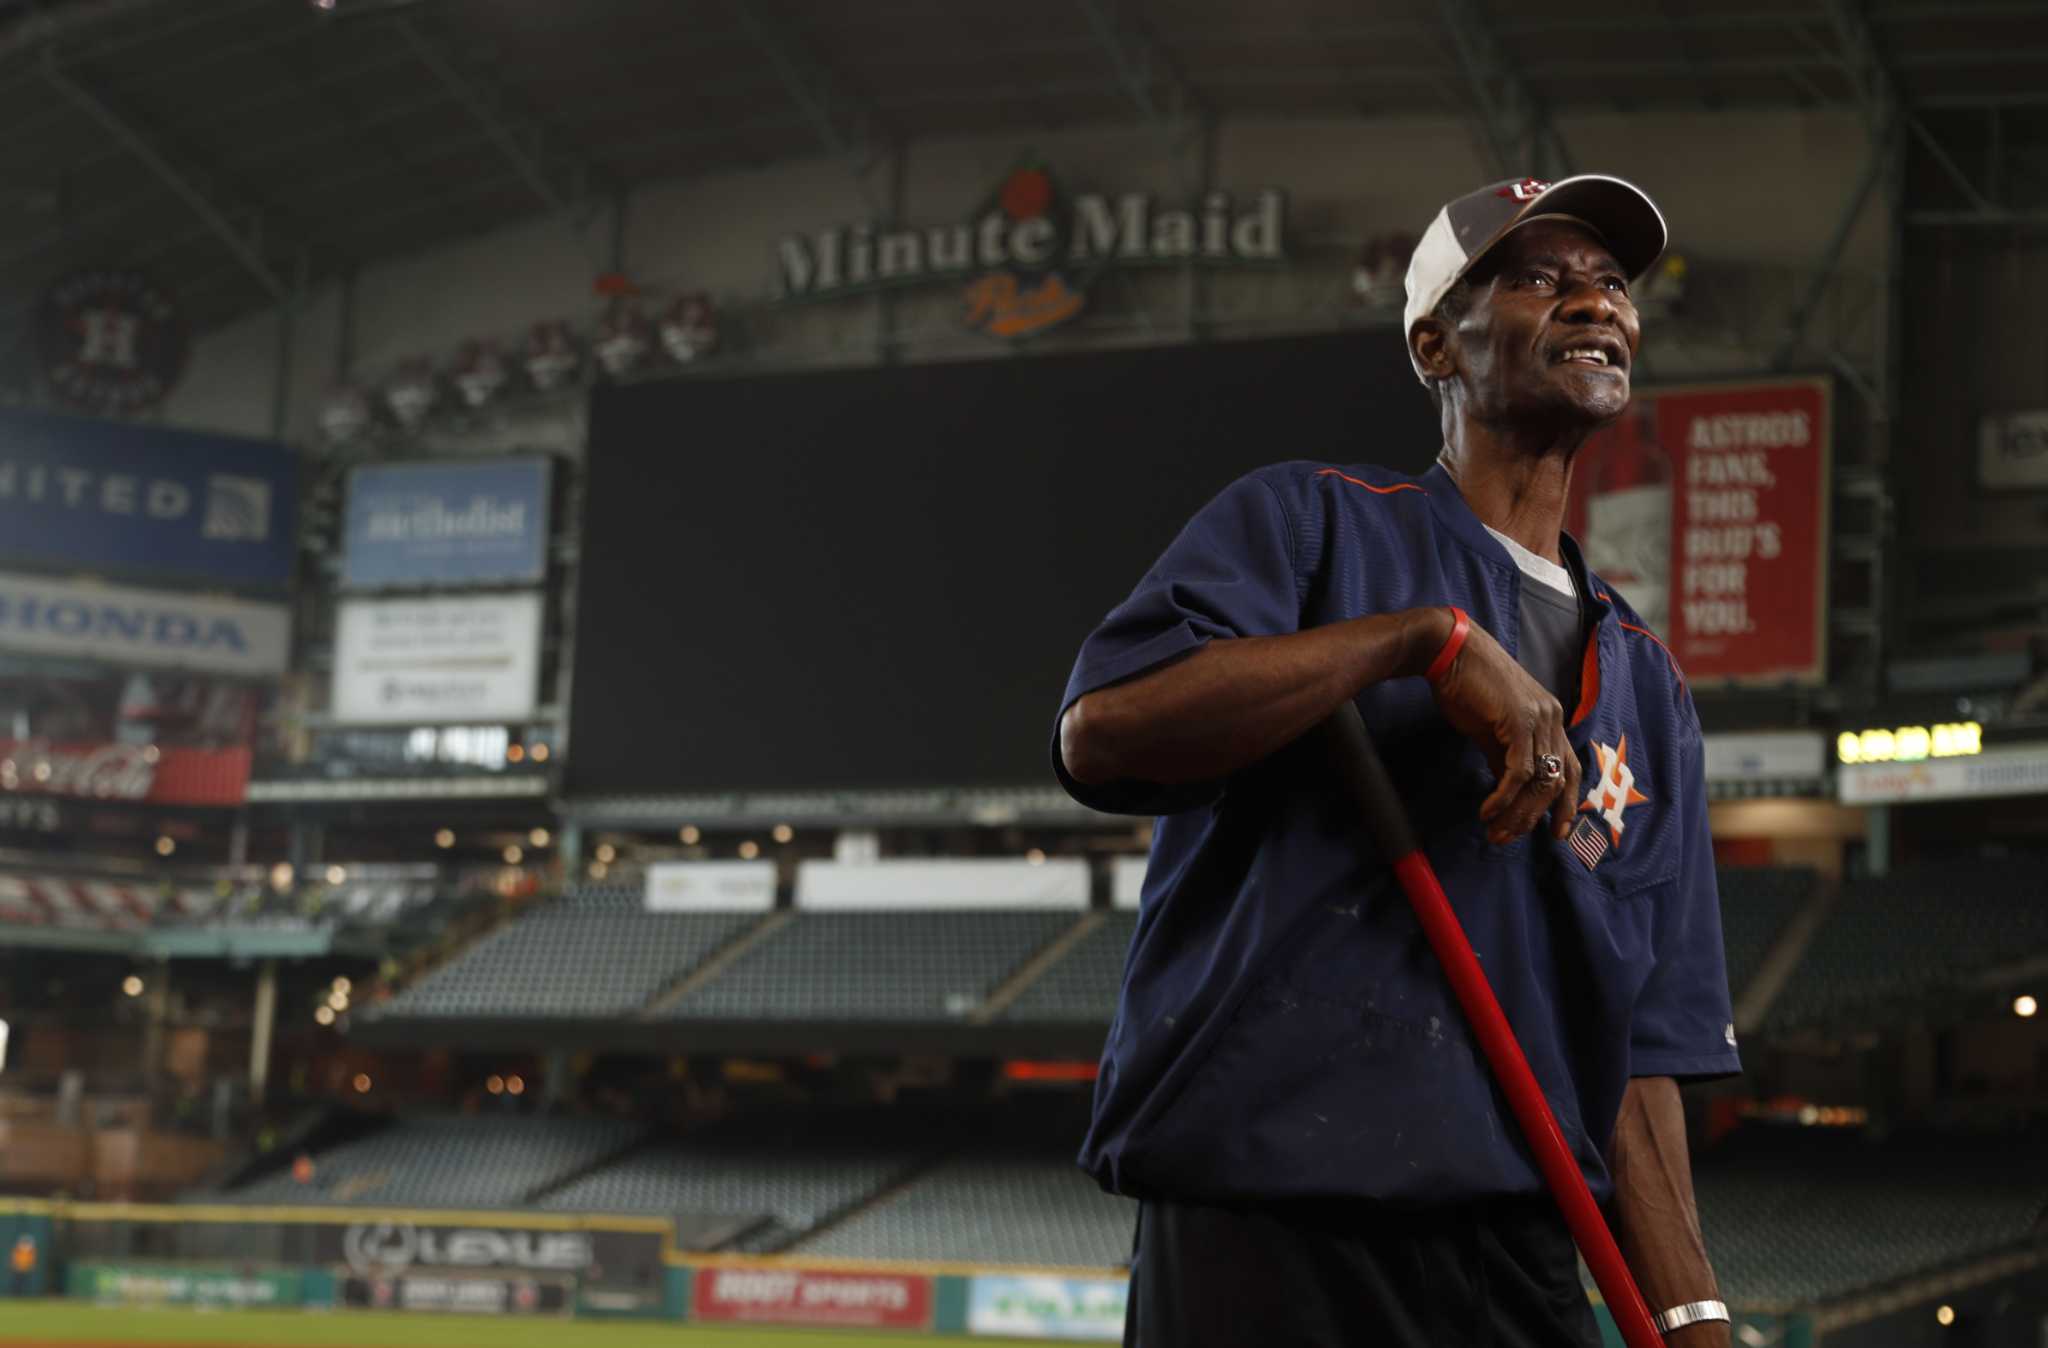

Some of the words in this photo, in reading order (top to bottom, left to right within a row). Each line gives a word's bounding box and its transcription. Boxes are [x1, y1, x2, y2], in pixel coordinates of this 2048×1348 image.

[781, 216, 1056, 290] Minute
[1073, 191, 1281, 257] Maid
[1690, 412, 1810, 447] ASTROS
[1688, 453, 1776, 488] FANS,
[1688, 490, 1757, 521] THIS
[1685, 523, 1781, 560] BUD'S
[1683, 563, 1747, 595] FOR
[0, 595, 250, 656] HONDA
[1682, 600, 1755, 634] YOU.
[419, 1228, 593, 1268] LEXUS
